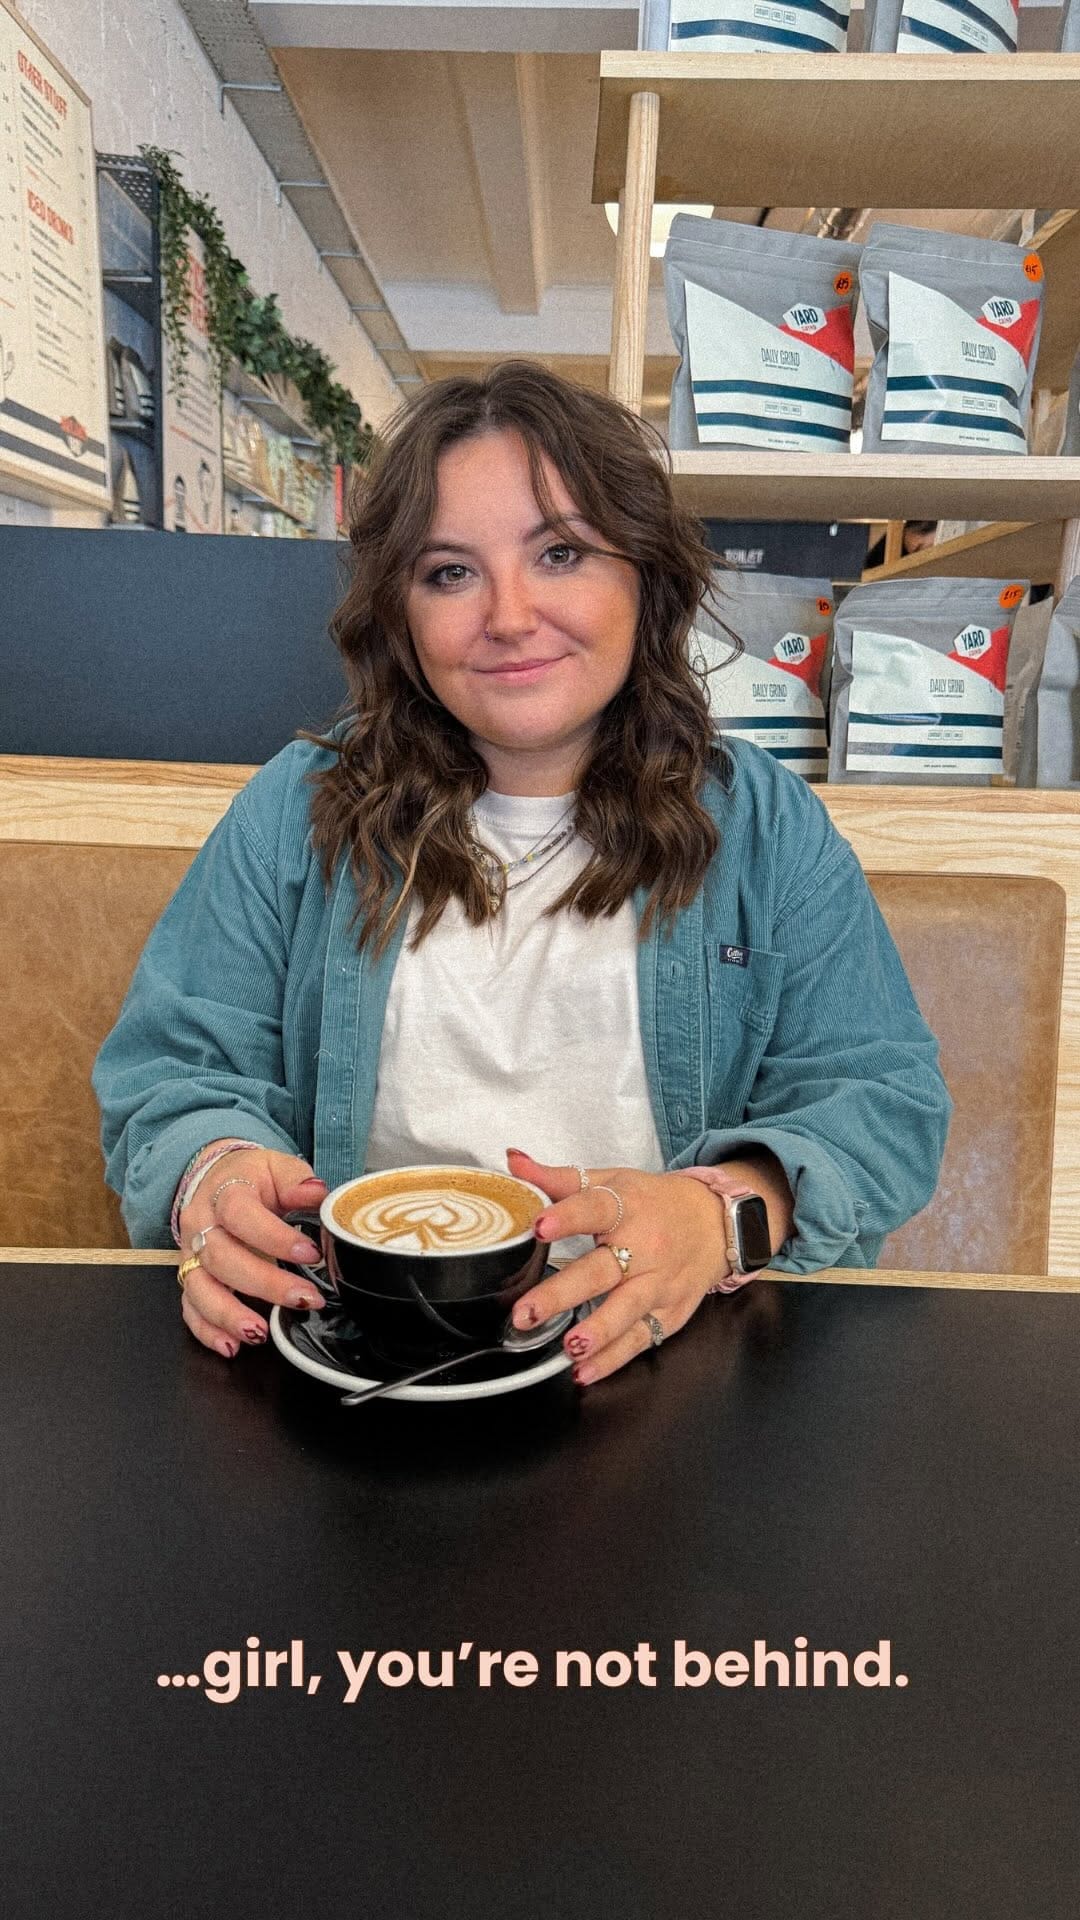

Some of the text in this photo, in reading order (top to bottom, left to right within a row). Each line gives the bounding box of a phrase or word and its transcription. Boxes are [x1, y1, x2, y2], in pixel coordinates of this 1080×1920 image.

[17, 49, 43, 95] OTHER
[43, 79, 67, 120] STUFF
[791, 308, 819, 326] YARD
[988, 300, 1015, 318] YARD
[761, 348, 800, 367] DAILY GRIND
[961, 341, 997, 361] DAILY GRIND
[724, 548, 764, 564] TOILET
[780, 637, 805, 657] YARD
[961, 630, 985, 651] YARD
[752, 683, 788, 697] DAILY GRIND
[930, 679, 965, 693] DAILY GRIND
